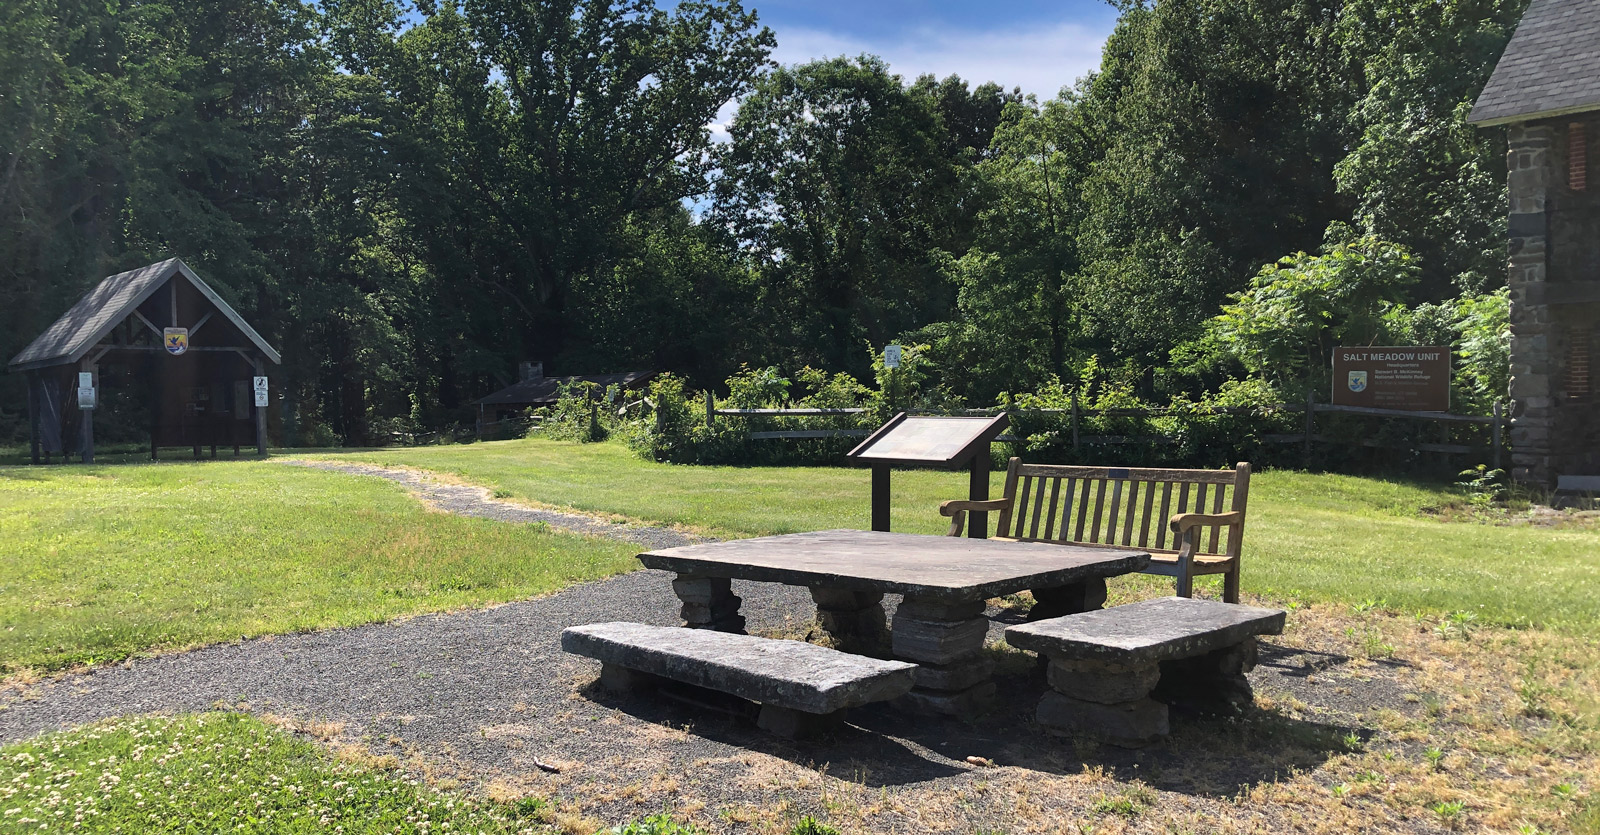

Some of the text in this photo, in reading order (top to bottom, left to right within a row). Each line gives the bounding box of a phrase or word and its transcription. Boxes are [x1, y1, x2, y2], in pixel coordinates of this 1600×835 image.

[1343, 352, 1440, 361] SALT MEADOW UNIT
